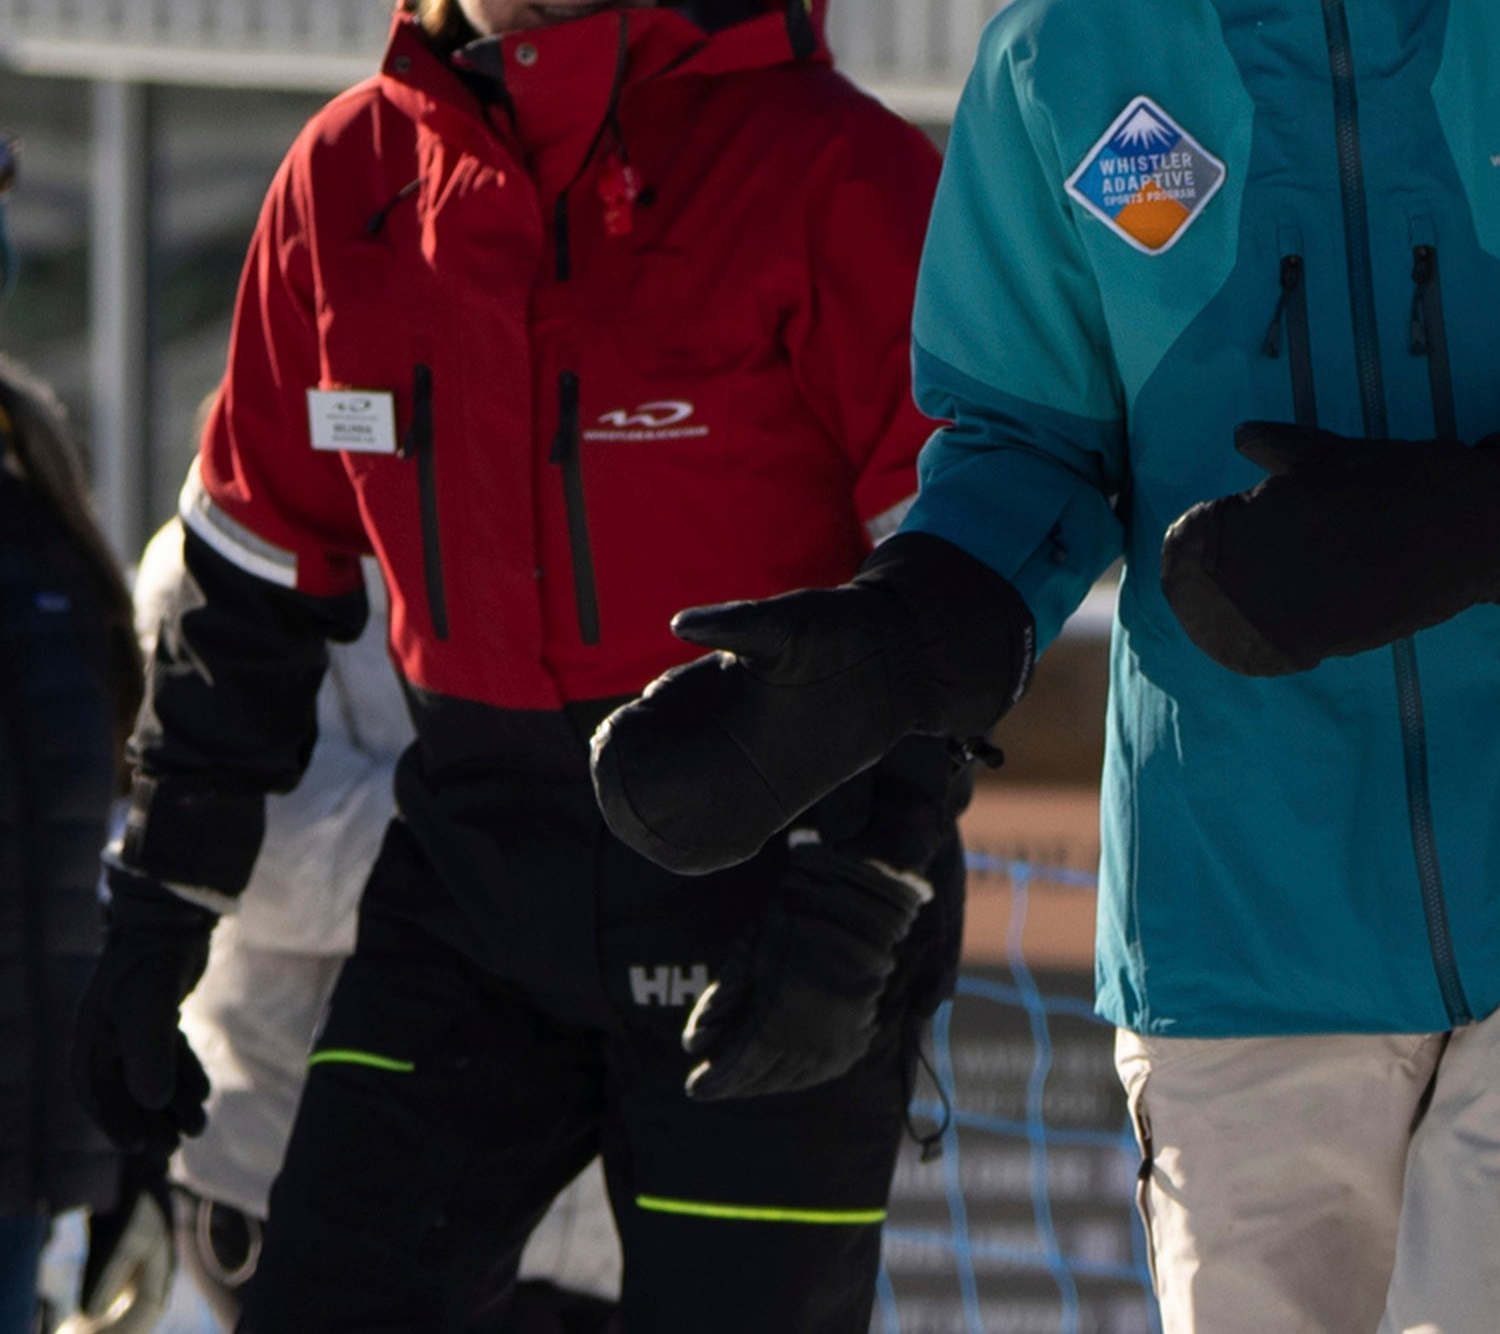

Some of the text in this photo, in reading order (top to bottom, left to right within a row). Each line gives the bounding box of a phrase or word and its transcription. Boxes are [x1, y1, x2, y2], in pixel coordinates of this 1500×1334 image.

[1101, 152, 1193, 176] WHISTLER
[1102, 170, 1195, 195] ADAPTIVE
[1103, 192, 1144, 207] SPORTS
[629, 964, 709, 1006] HH
